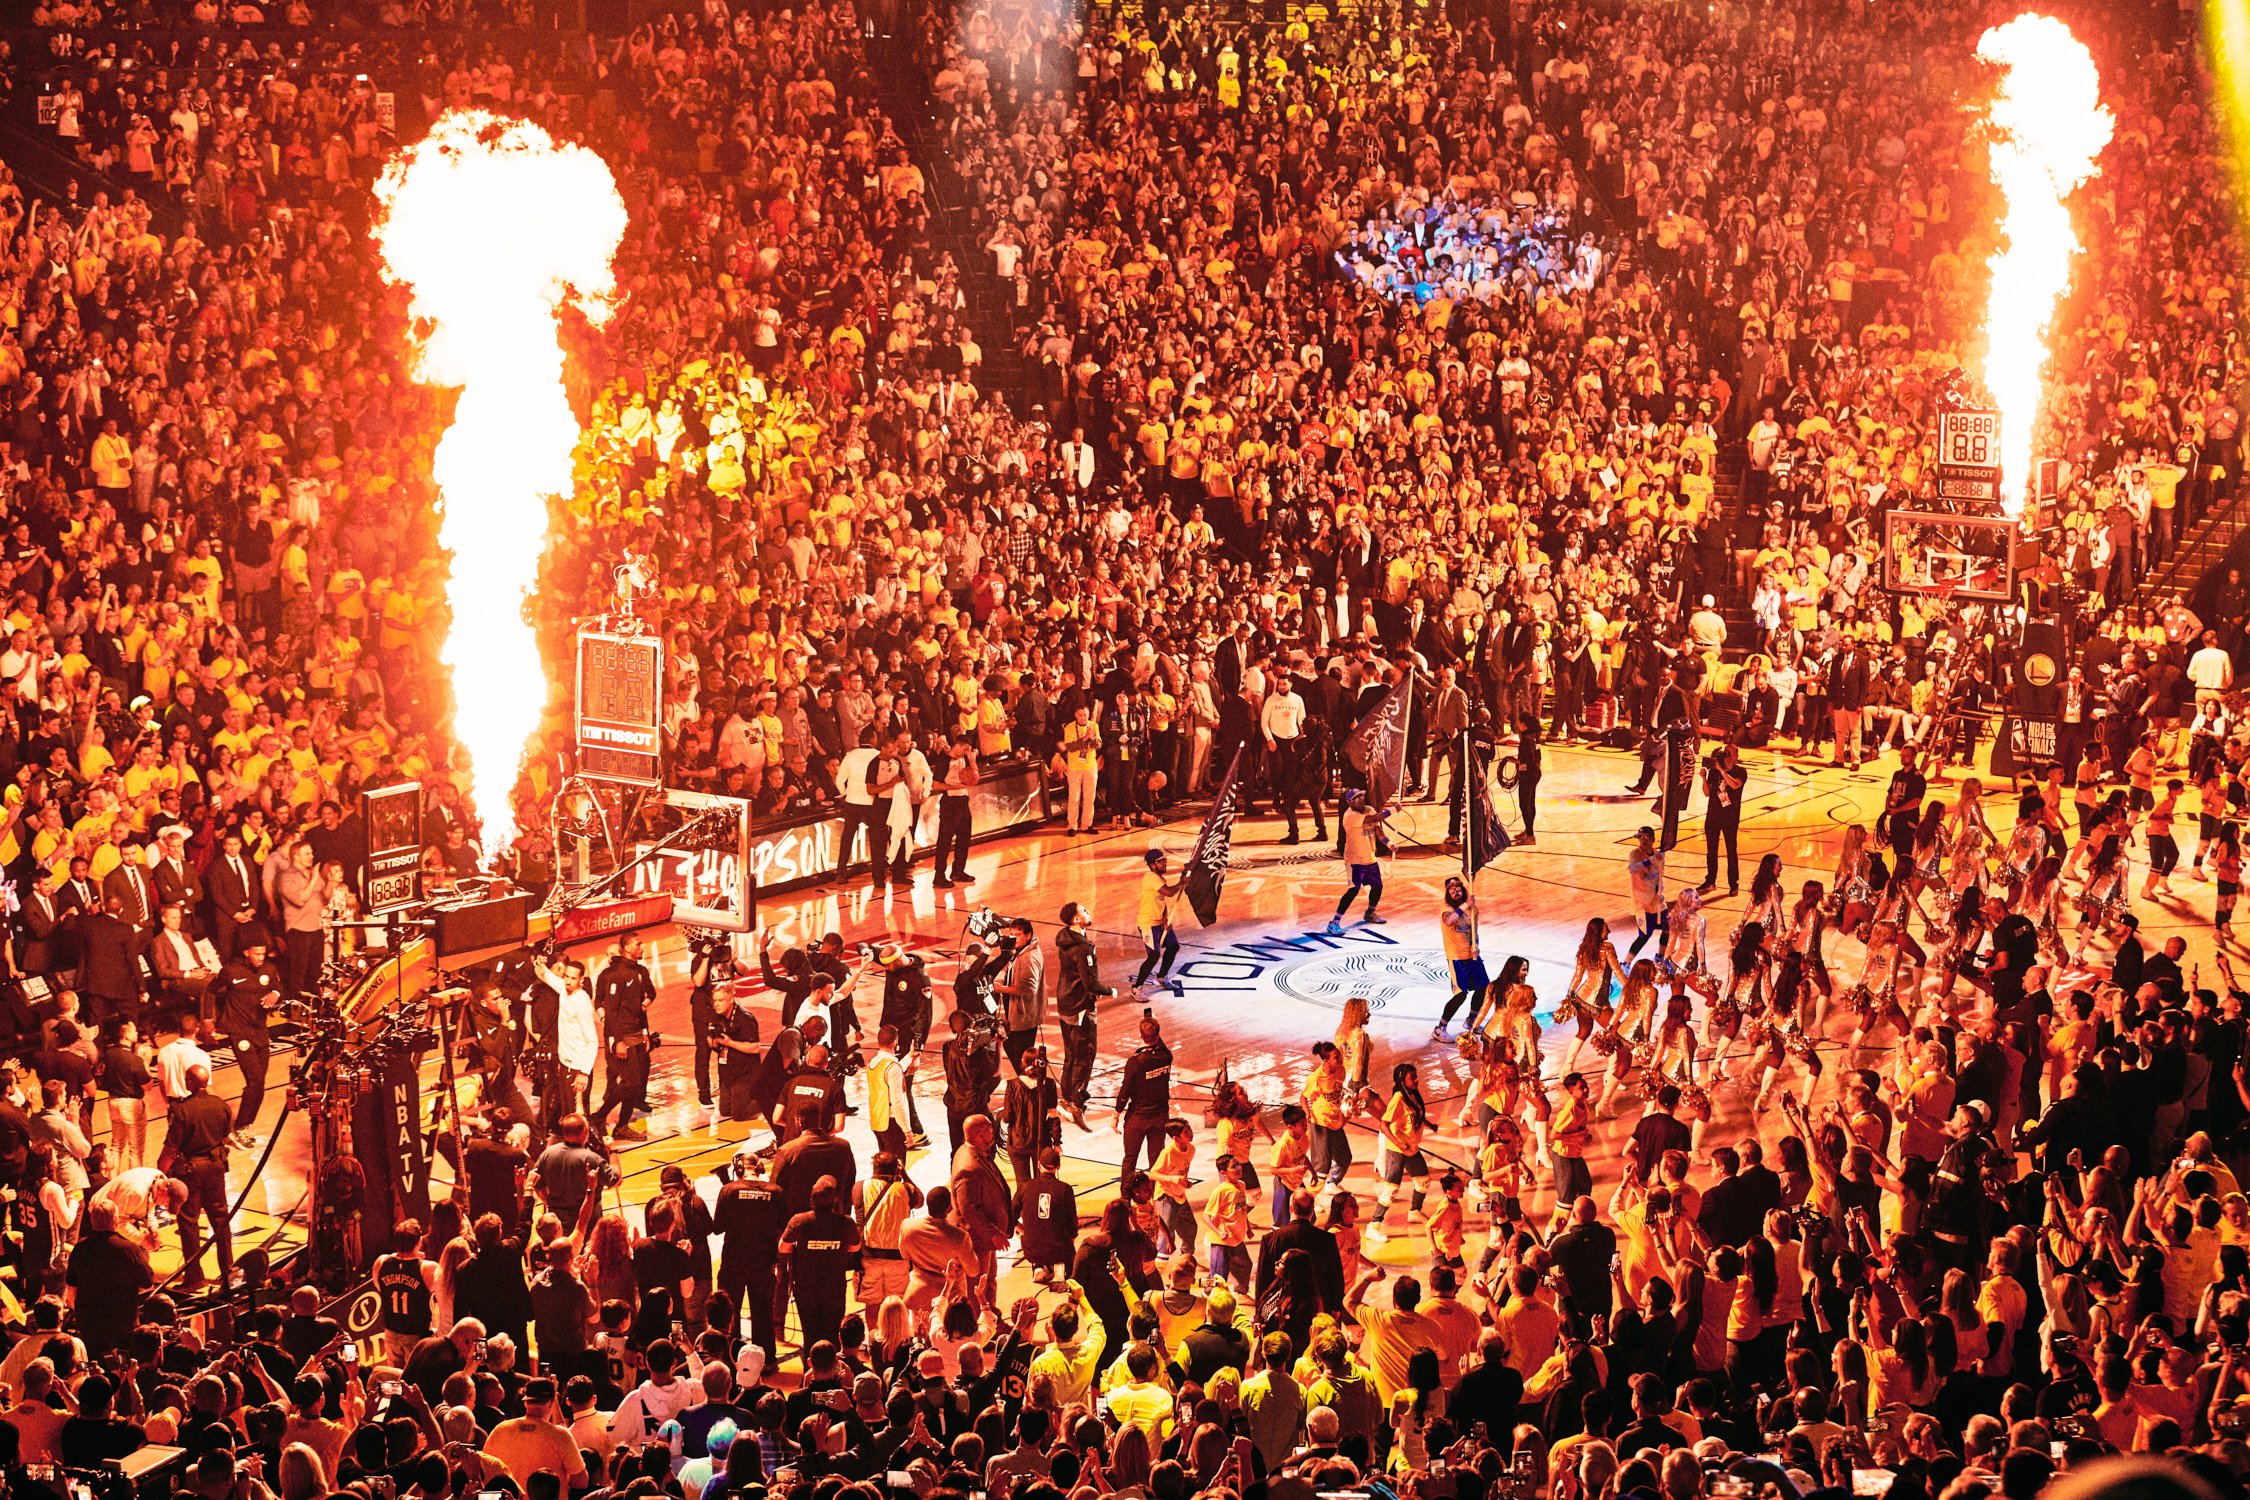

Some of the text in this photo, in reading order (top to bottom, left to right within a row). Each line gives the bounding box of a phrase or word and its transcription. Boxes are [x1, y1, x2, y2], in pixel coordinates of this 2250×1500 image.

[39, 109, 58, 121] 102
[377, 104, 393, 116] 03
[1957, 468, 1995, 479] TISSOT
[601, 726, 656, 747] TISSOT
[2028, 721, 2046, 739] NBA
[385, 852, 421, 869] TISSOT
[1171, 928, 1400, 998] TOWN
[1145, 1064, 1171, 1080] ESPN
[793, 1085, 825, 1099] ESPN
[738, 1189, 772, 1202] ESPN
[18, 1202, 38, 1229] 35
[807, 1239, 841, 1251] ESPN
[381, 1273, 421, 1290] THOMPSON
[390, 1290, 409, 1315] 11
[1001, 1374, 1025, 1399] 13
